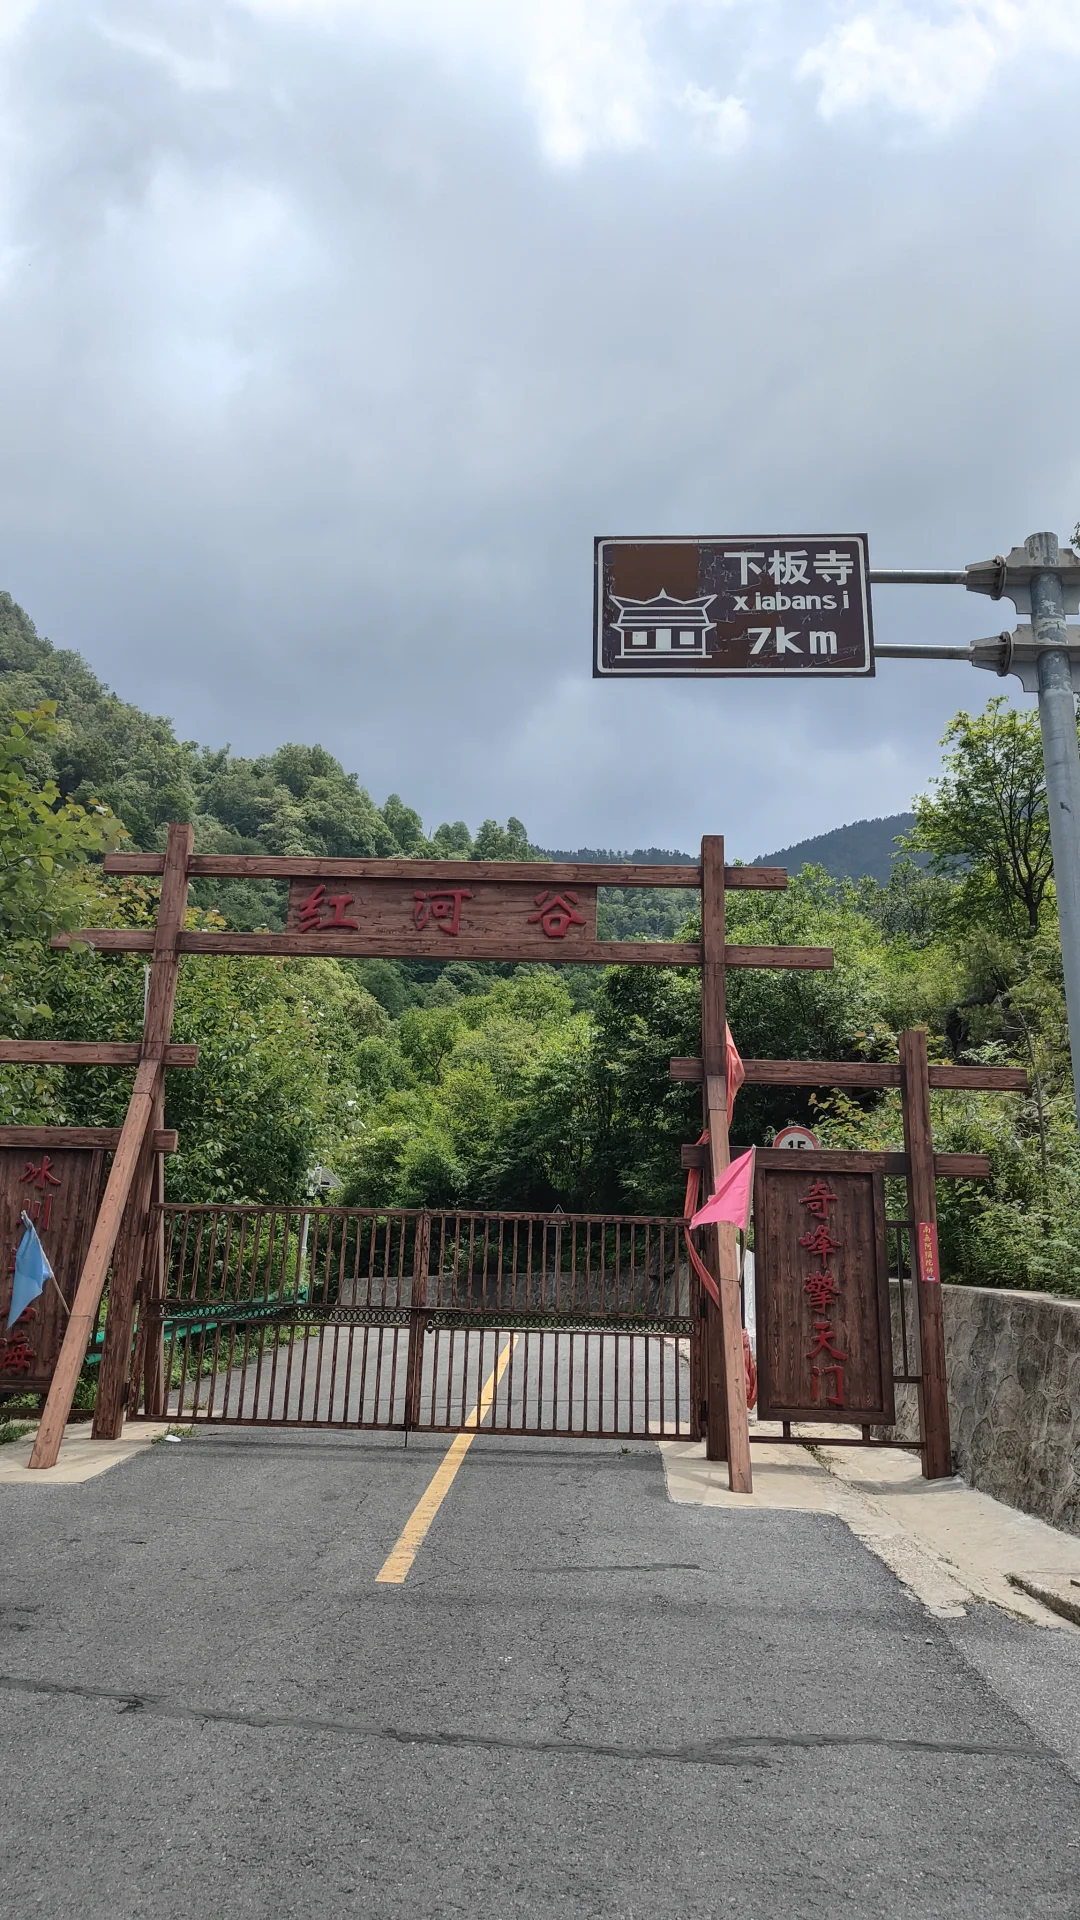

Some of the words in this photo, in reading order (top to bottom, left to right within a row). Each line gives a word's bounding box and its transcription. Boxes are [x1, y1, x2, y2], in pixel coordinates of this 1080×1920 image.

[724, 550, 854, 586] 下板寺
[299, 883, 586, 937] 红河谷
[0, 1155, 61, 1373] 冰川海
[799, 1178, 849, 1406] 奇峰擎天门
